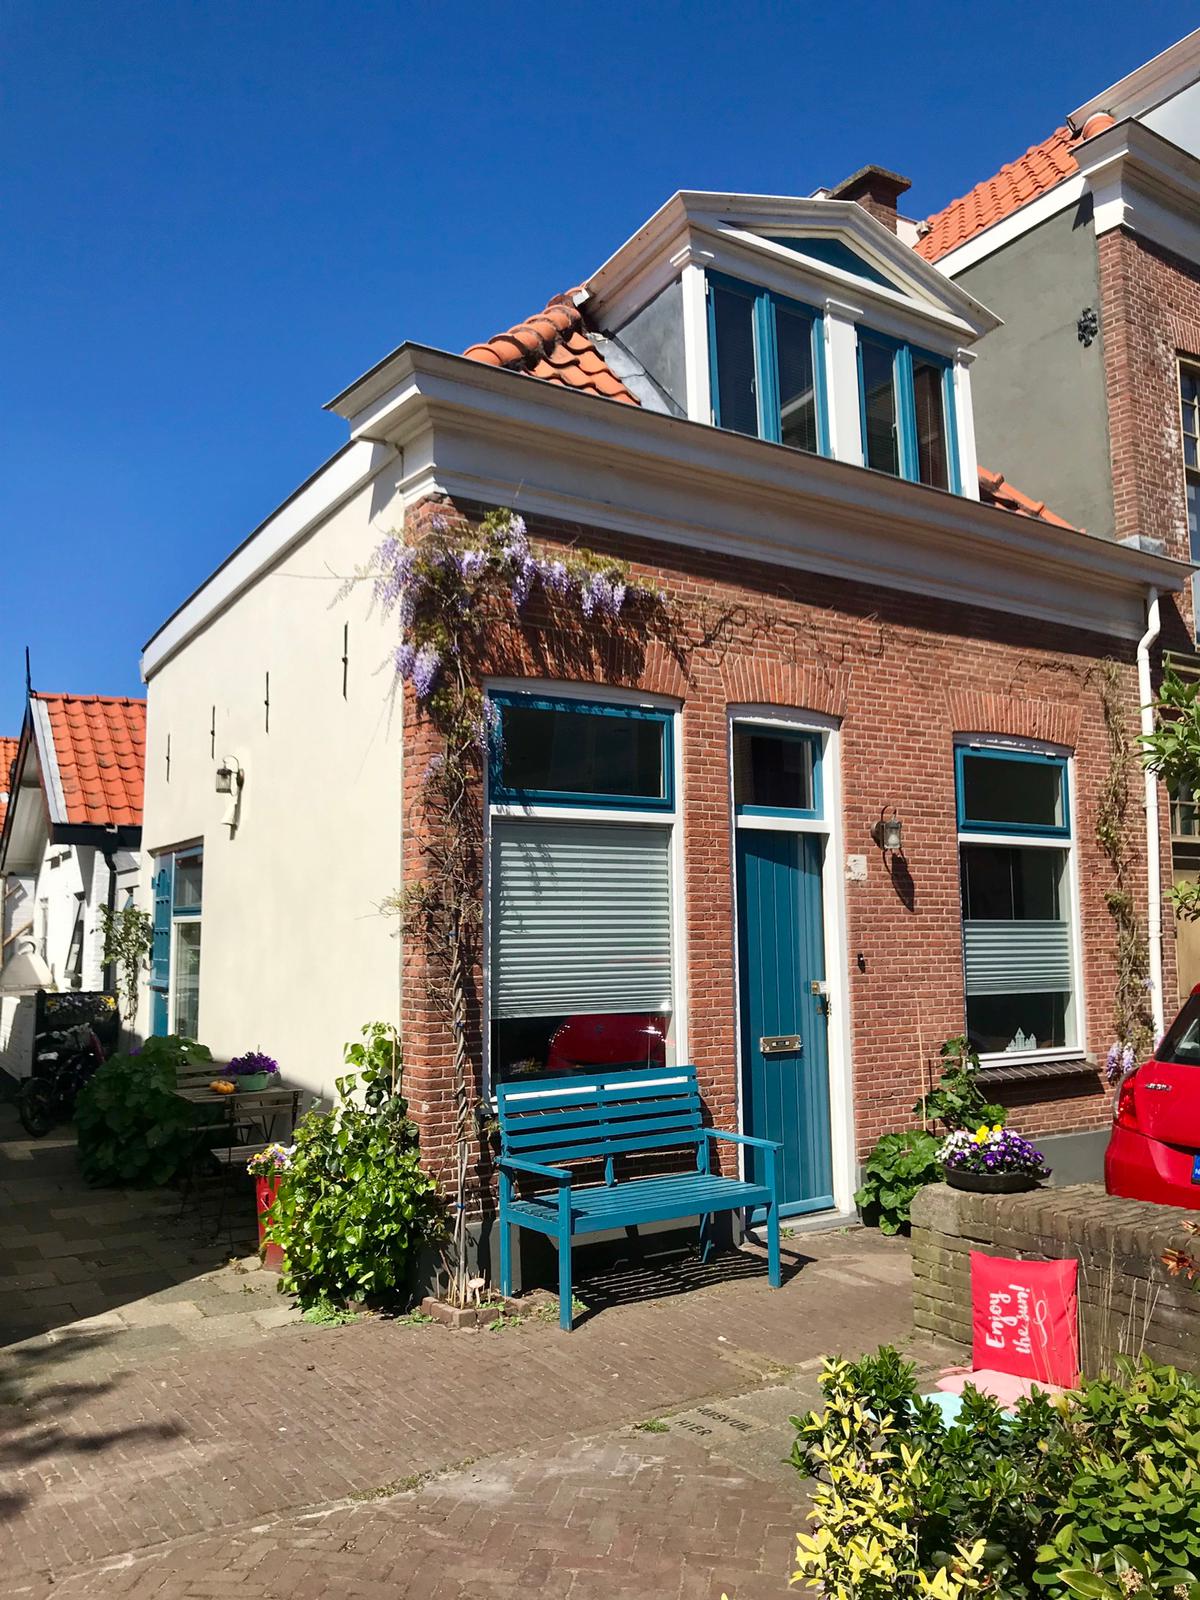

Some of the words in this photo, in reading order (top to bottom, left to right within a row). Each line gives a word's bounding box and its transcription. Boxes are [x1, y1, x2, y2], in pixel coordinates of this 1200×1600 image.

[986, 1290, 1018, 1349] Enjoy
[1008, 1284, 1031, 1322] sun!
[1012, 1324, 1031, 1354] the
[674, 1419, 712, 1436] HIER
